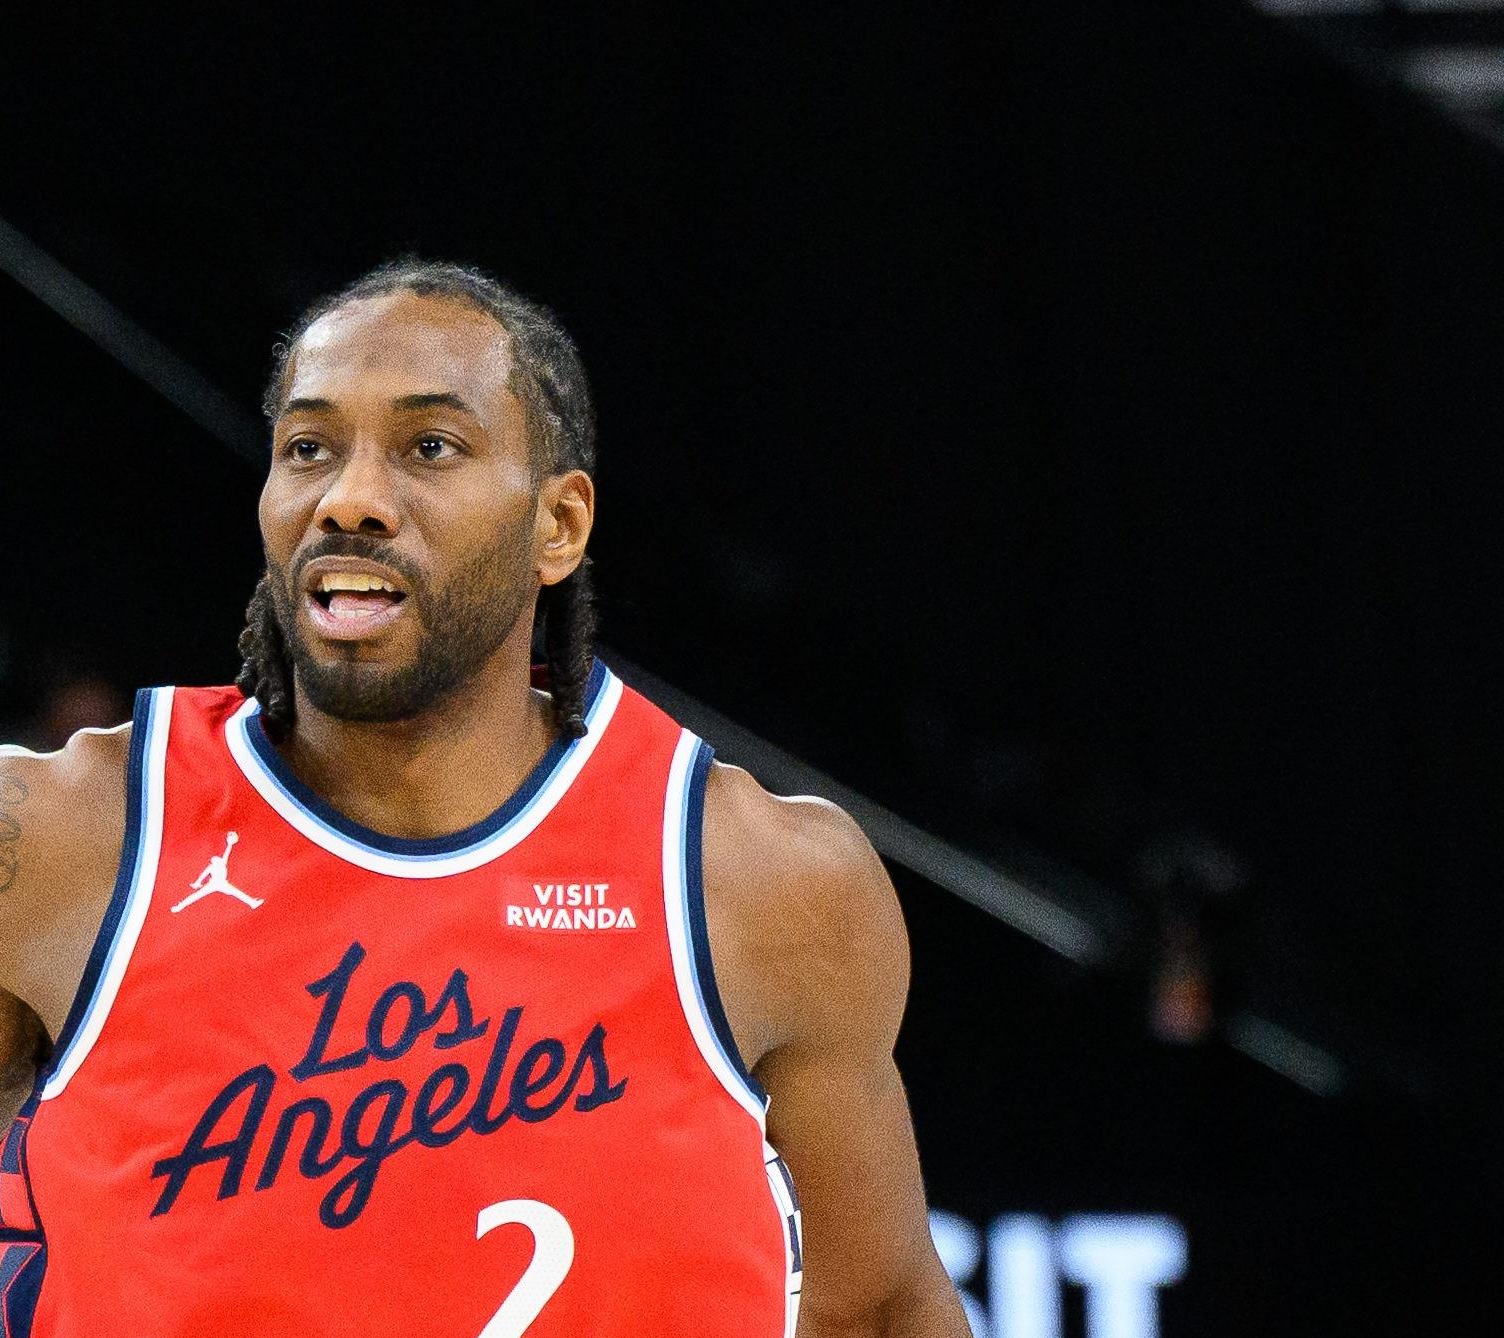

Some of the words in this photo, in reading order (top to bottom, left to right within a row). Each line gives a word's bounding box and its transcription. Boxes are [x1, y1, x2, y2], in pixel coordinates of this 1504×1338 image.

[506, 905, 637, 930] RWANDA
[533, 883, 609, 906] VISIT
[290, 942, 488, 1084] Los
[151, 1008, 628, 1229] Angeles
